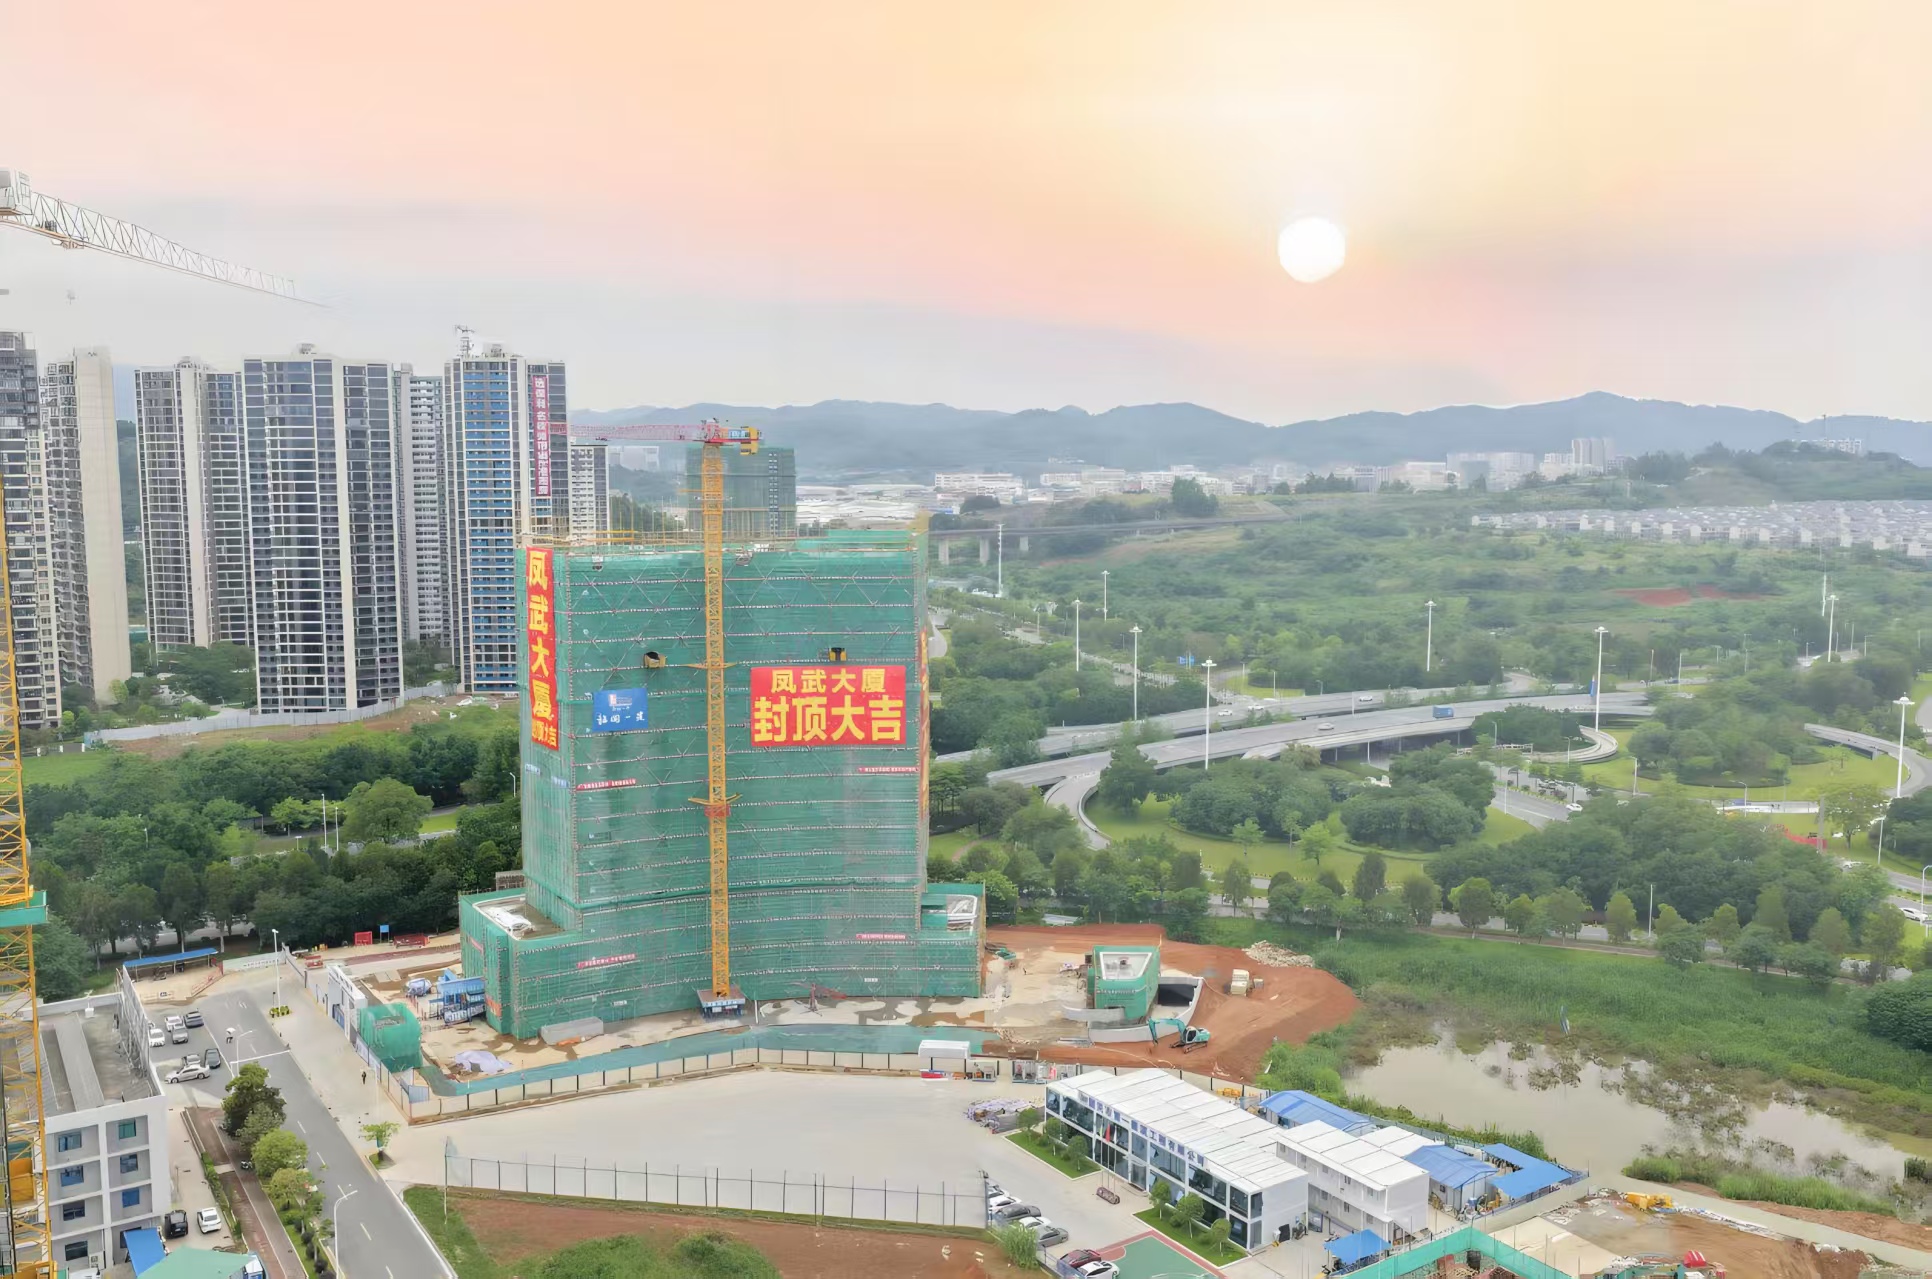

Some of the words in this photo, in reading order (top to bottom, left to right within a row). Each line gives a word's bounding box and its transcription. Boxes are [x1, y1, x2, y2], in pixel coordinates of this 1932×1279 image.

[771, 668, 886, 693] 凤武大厦
[754, 694, 904, 742] 封顶大吉
